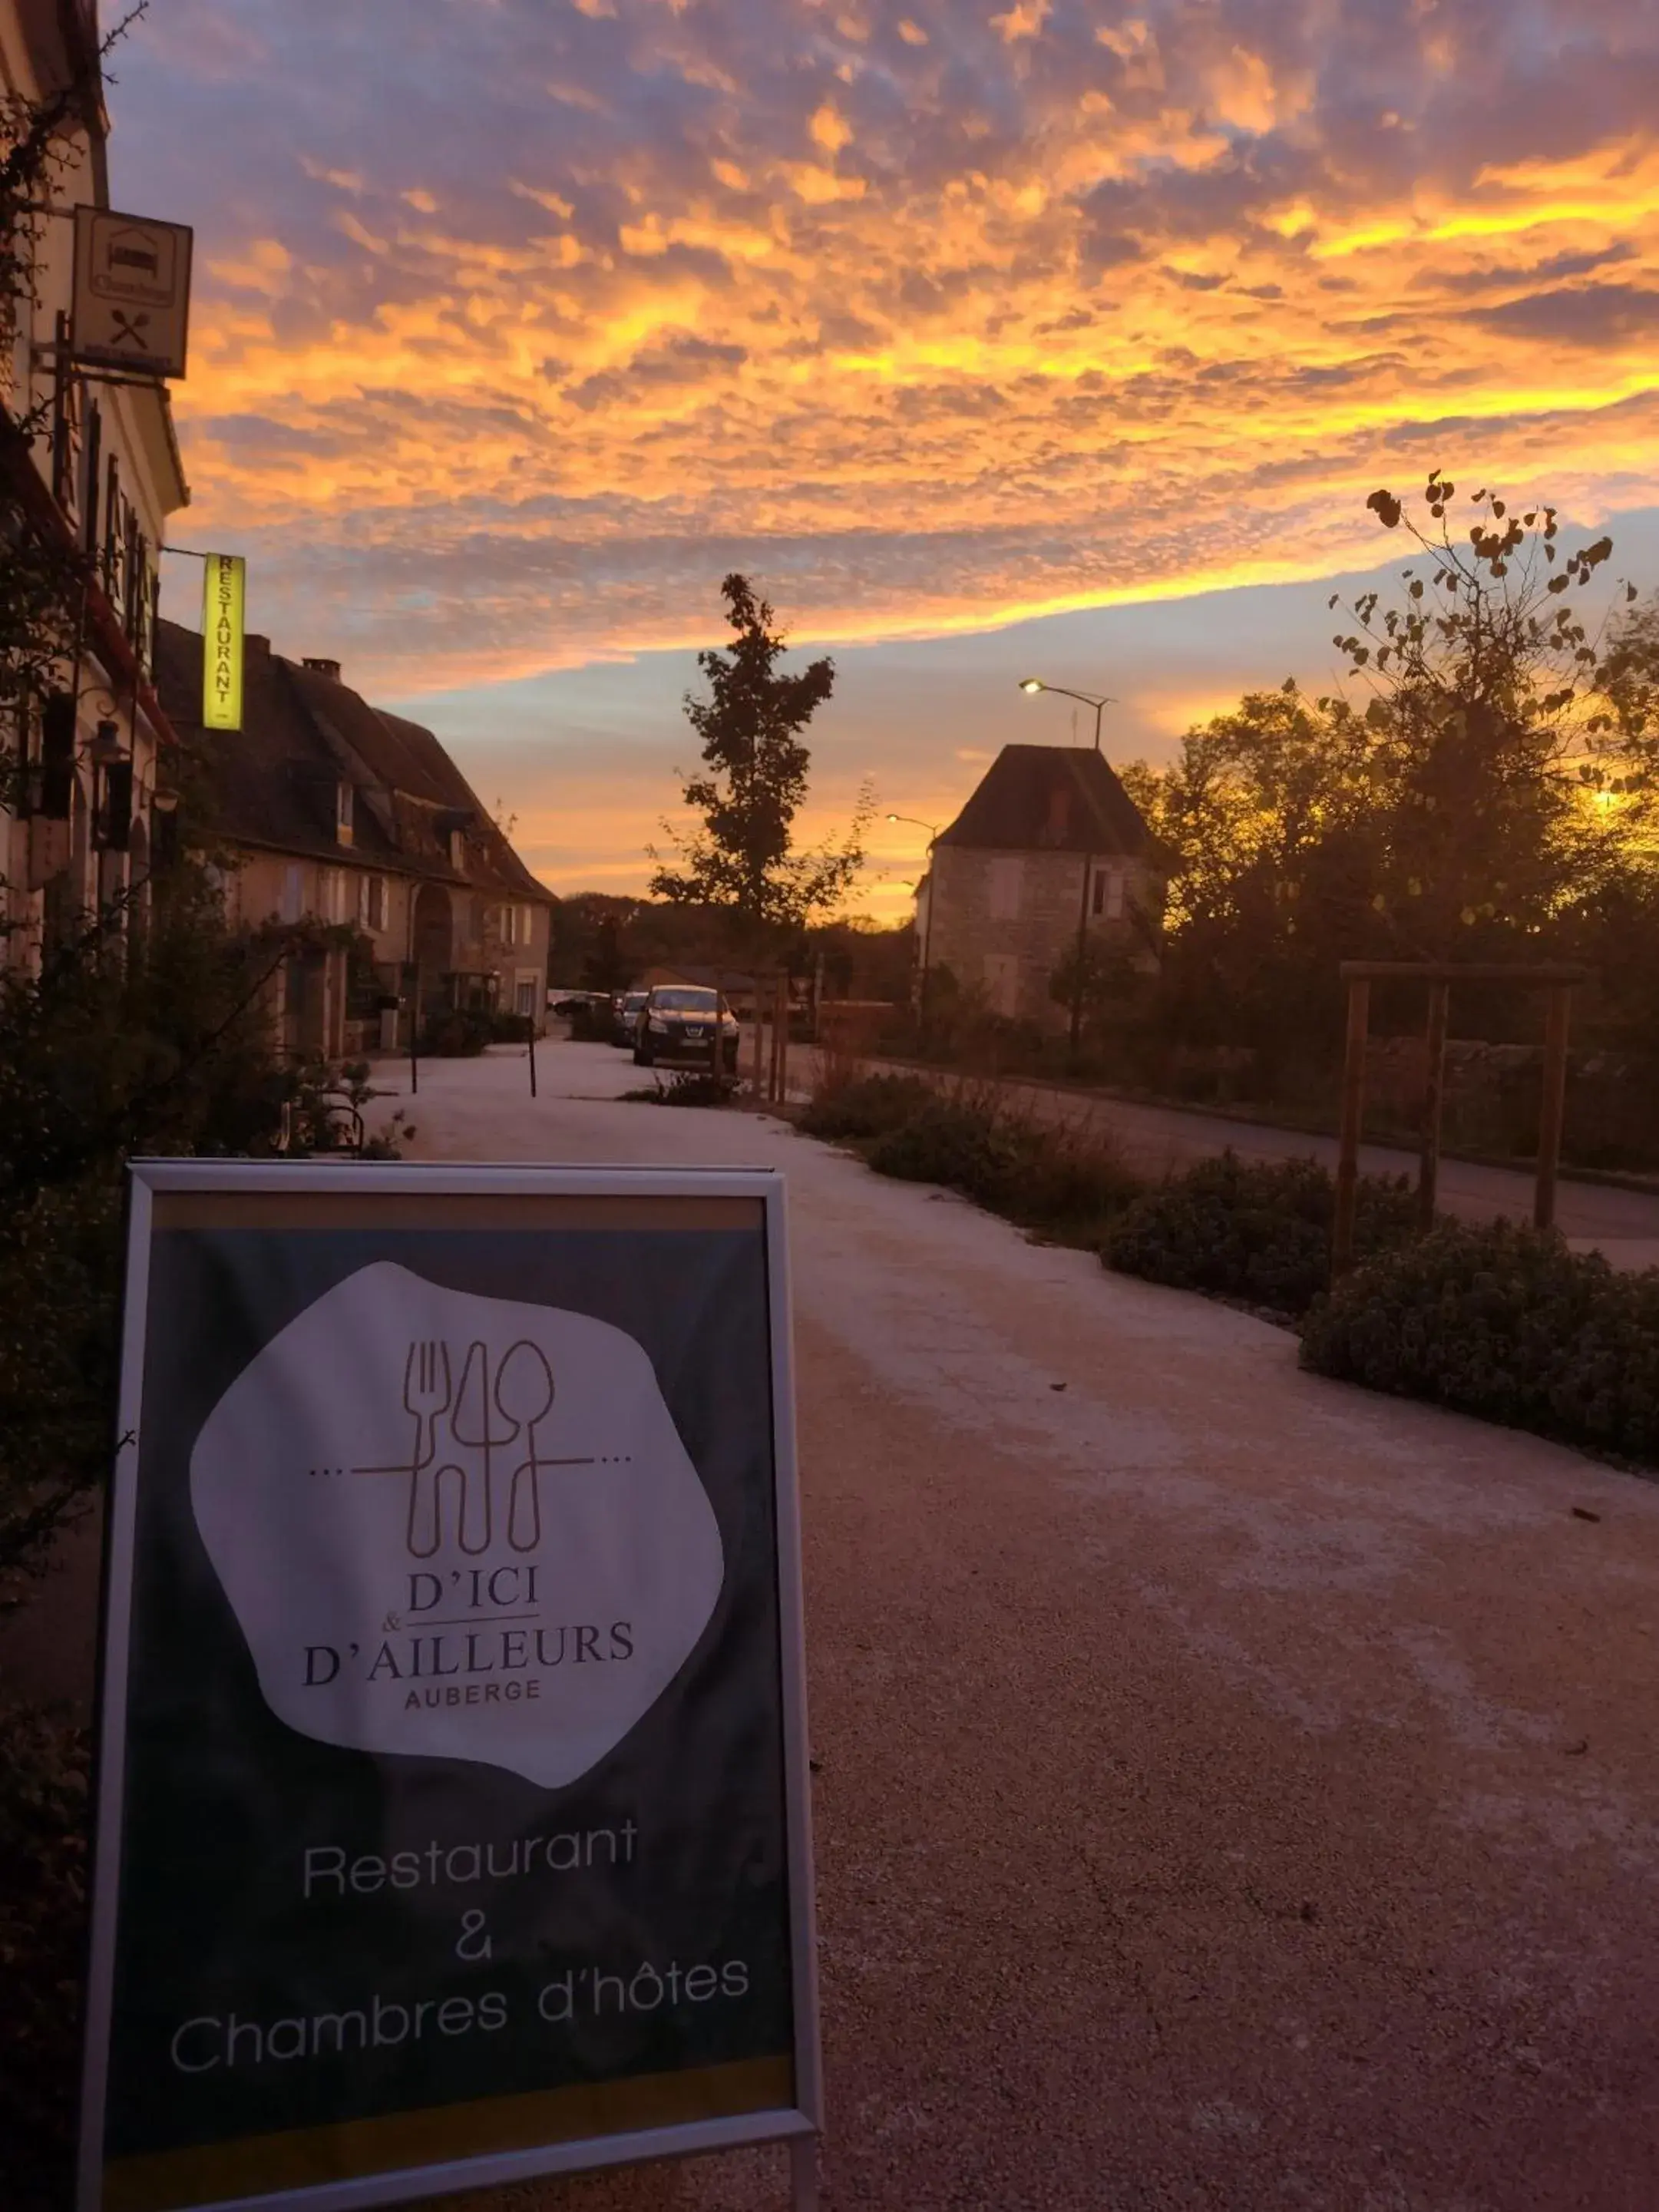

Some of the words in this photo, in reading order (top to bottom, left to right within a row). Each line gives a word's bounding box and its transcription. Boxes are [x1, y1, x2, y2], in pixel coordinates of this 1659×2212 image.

[216, 555, 233, 703] RESTAURANT
[382, 1612, 401, 1632] &
[405, 1680, 541, 1711] AUBERGE
[304, 1819, 638, 1898] Restaurant
[455, 1909, 492, 1960] &
[170, 1992, 508, 2073] Chambres
